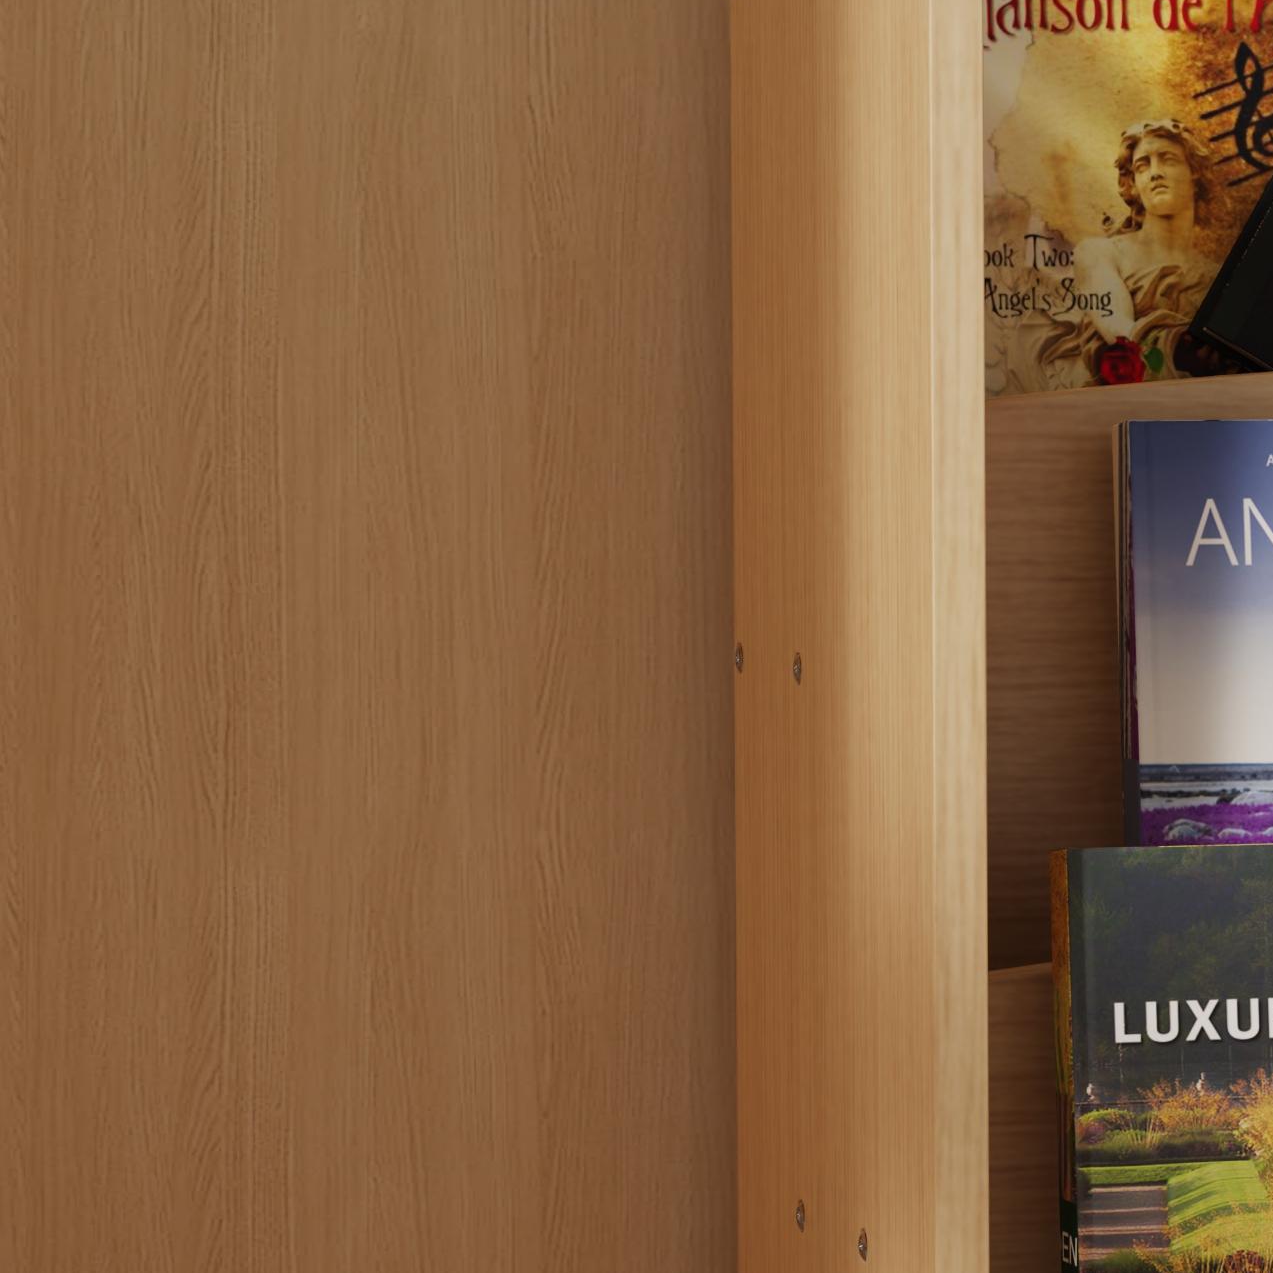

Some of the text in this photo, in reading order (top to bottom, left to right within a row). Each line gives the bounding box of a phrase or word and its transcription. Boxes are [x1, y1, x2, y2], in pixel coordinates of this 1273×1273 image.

[1024, 233, 1075, 272] Two:
[984, 277, 1114, 319] Angel's Song
